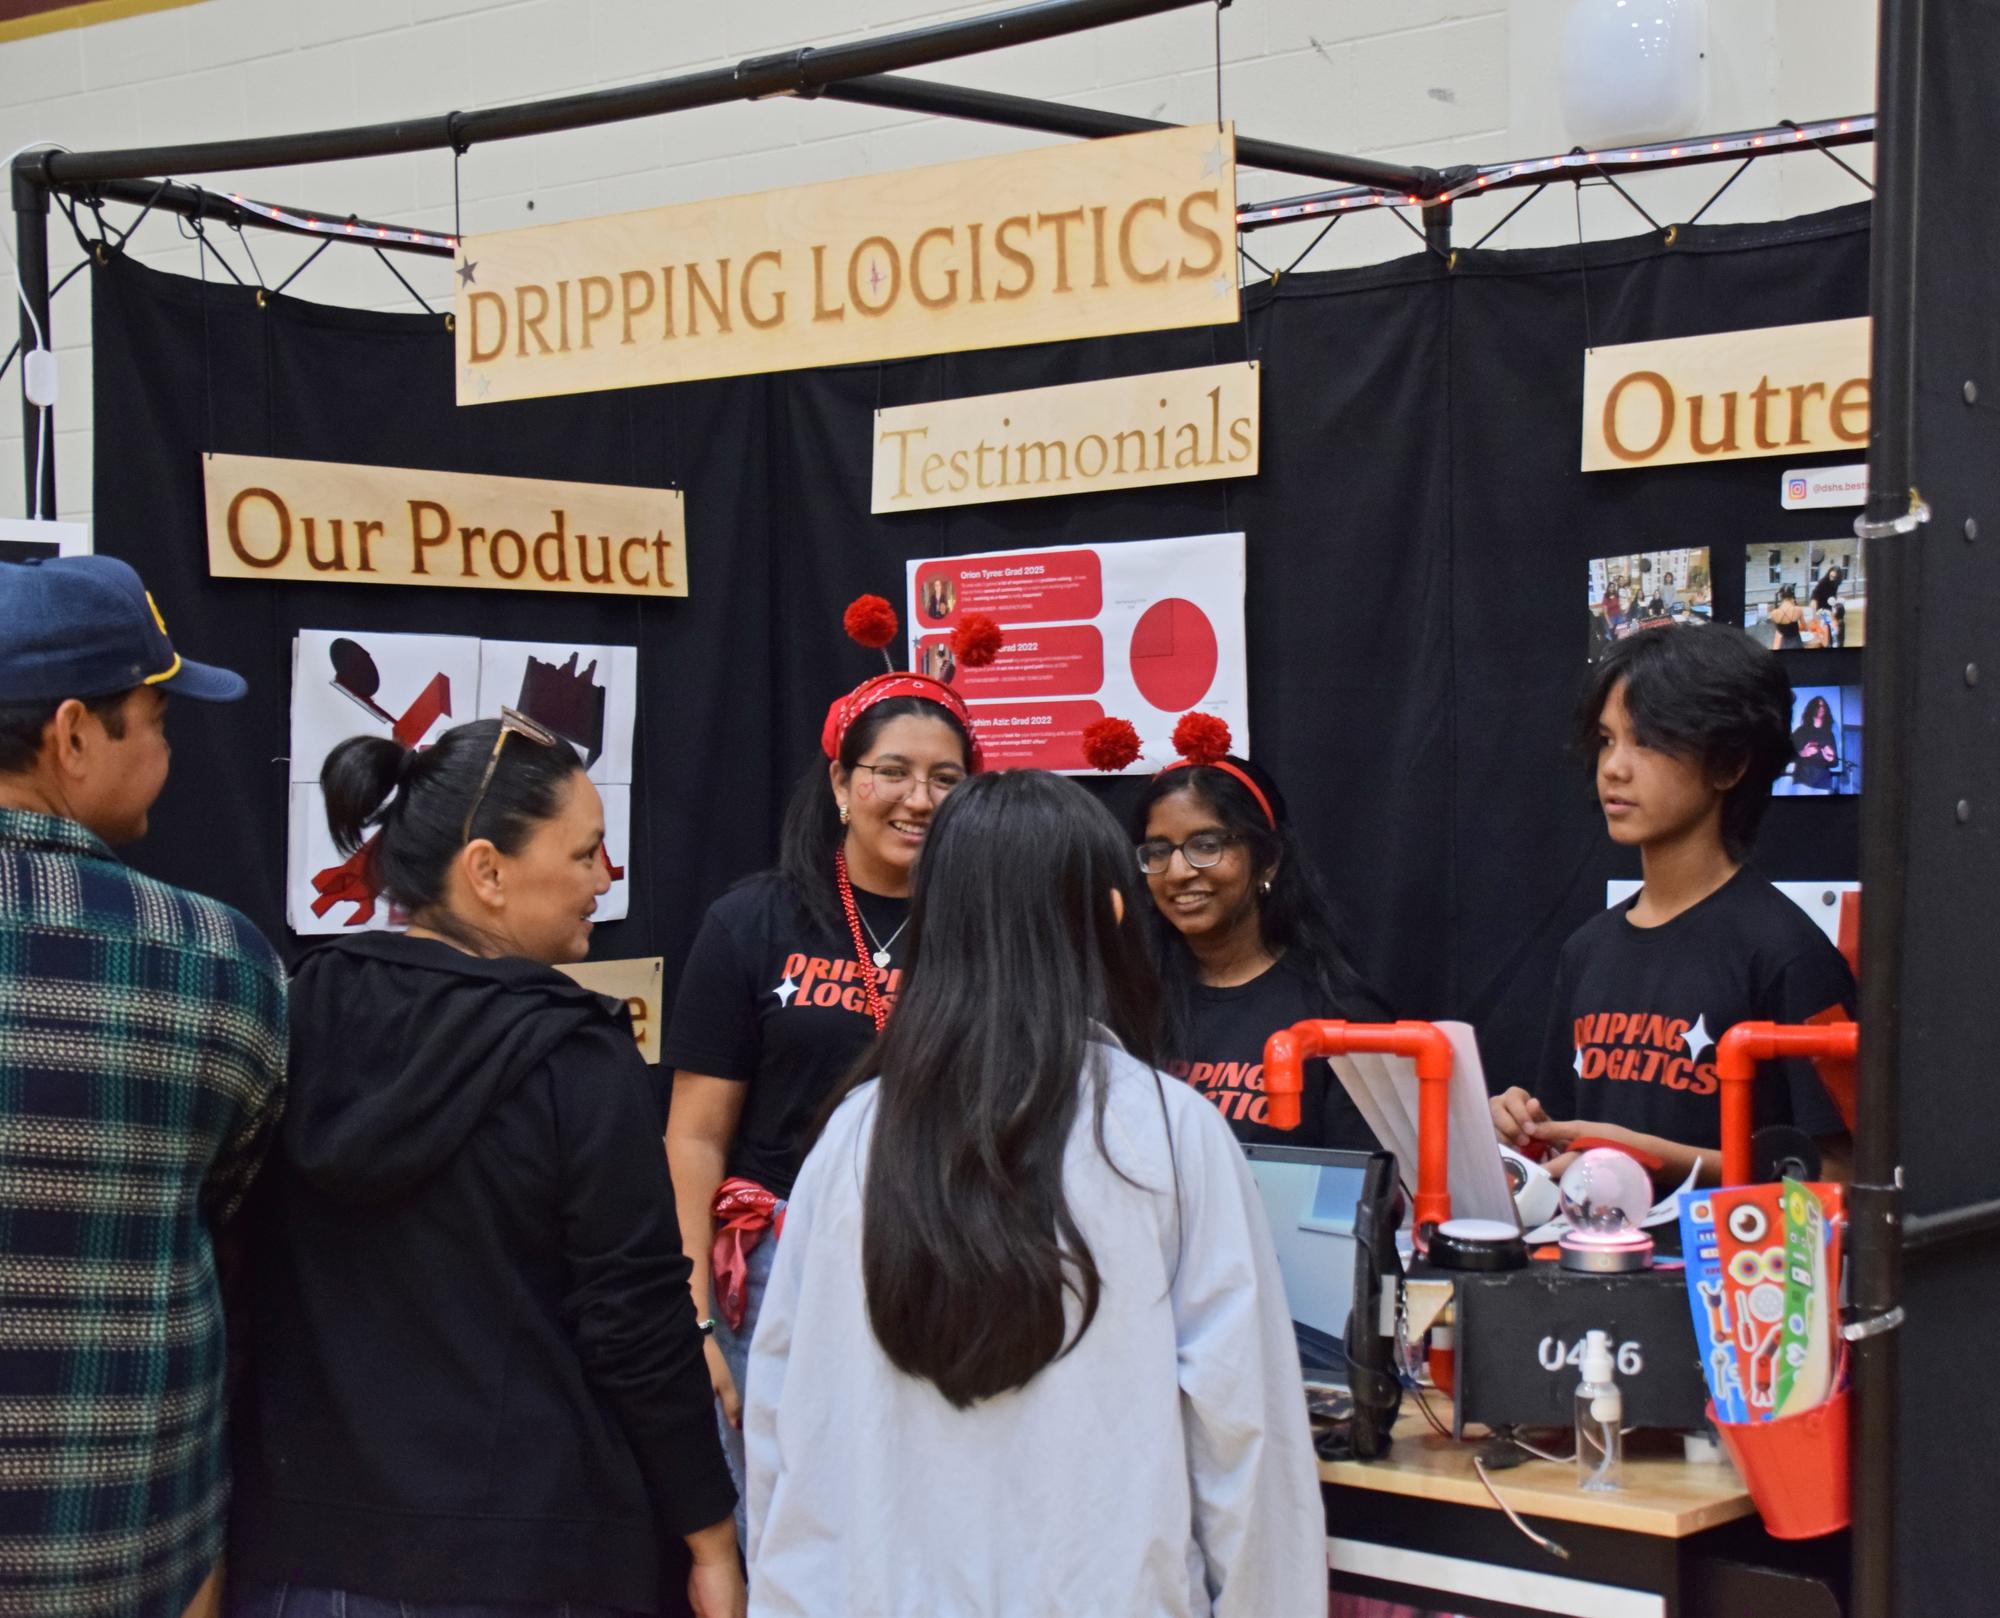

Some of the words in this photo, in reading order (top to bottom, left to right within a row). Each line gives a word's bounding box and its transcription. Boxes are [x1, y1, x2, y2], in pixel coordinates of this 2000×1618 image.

[468, 249, 787, 364] DRIPPING
[810, 188, 1224, 323] LOGISTICS
[879, 385, 1253, 501] Testimonials
[1602, 370, 1869, 462] Outre
[226, 487, 383, 572] Our
[407, 500, 674, 588] Product
[1004, 567, 1023, 576] Grad
[1538, 1336, 1643, 1375] 046
